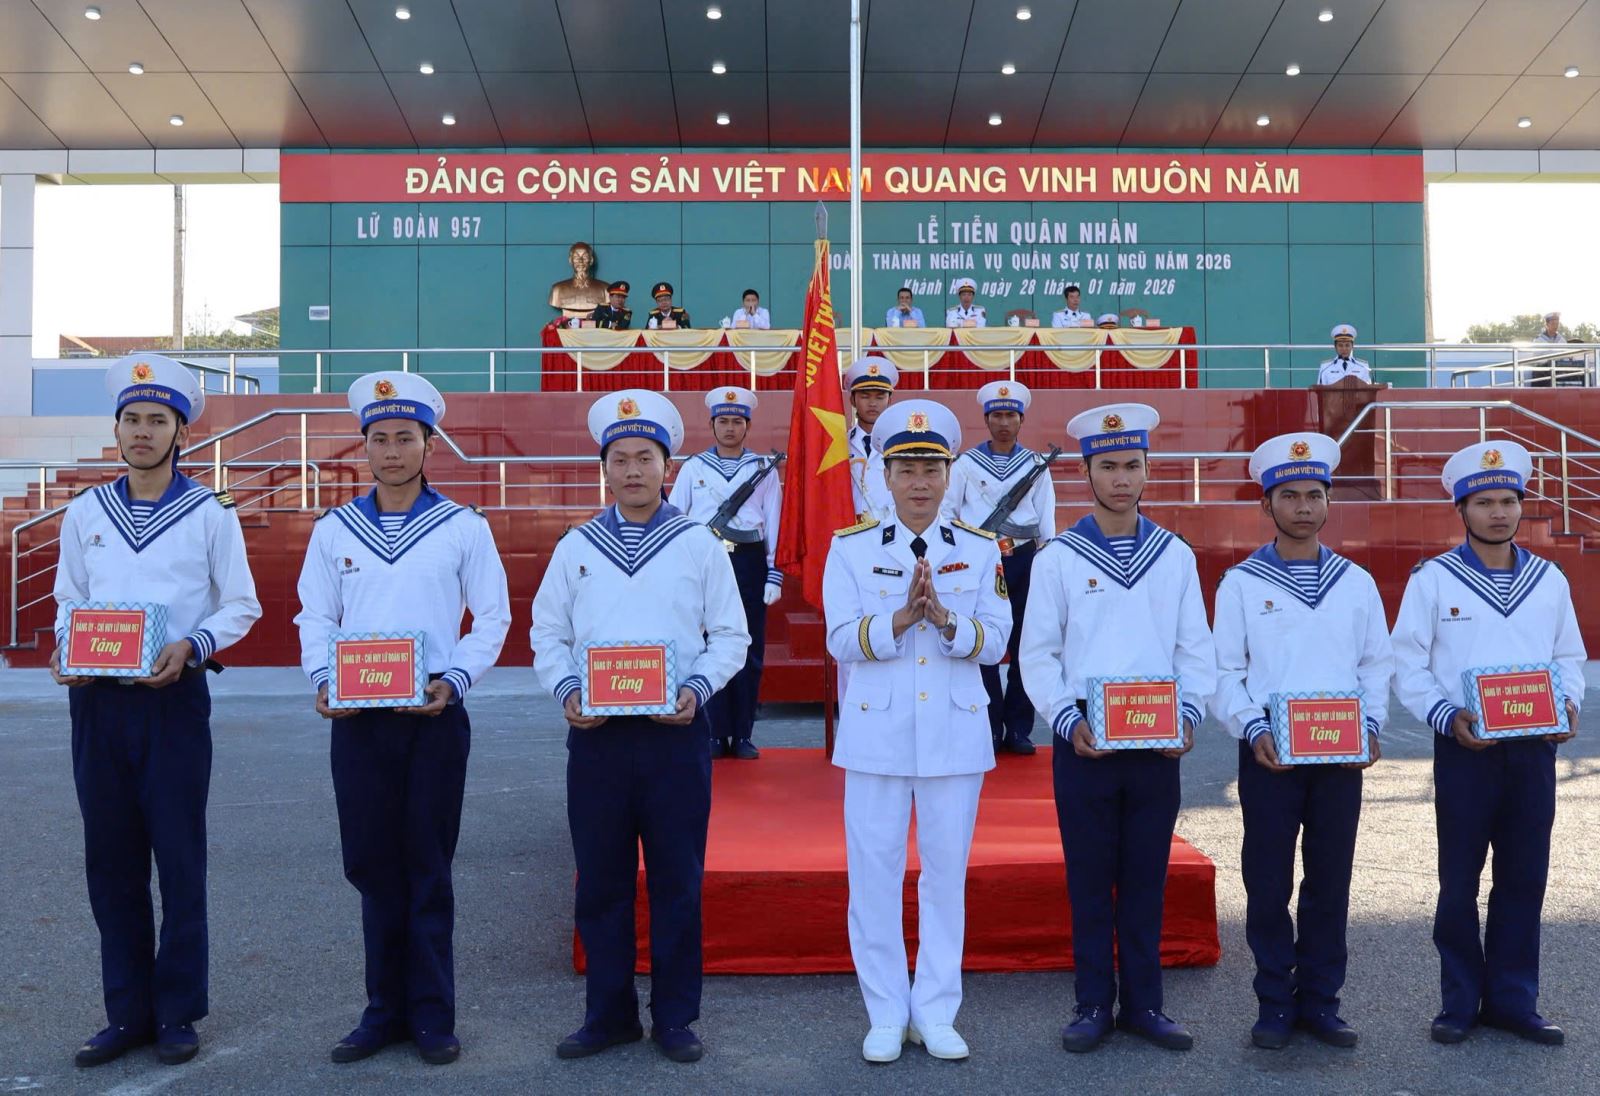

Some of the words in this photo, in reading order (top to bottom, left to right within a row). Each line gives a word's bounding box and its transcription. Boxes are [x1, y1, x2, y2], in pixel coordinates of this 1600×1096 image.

[406, 157, 504, 194] ĐẢNG
[517, 160, 617, 199] CỘNG
[630, 156, 699, 194] SẢN
[712, 160, 785, 199] VIỆT
[798, 167, 872, 193] NAM
[885, 165, 1007, 195] QUANG
[1018, 167, 1097, 193] VINH
[1112, 160, 1211, 194] MUÔN
[1225, 160, 1300, 194] NĂM
[357, 211, 380, 238] LỮ
[393, 212, 439, 238] ĐOÀN
[451, 216, 481, 238] 957
[918, 215, 939, 243] LỄ
[951, 215, 998, 243] TIỄN
[1010, 217, 1067, 245] QUÂN
[1079, 217, 1138, 243] NHÂN
[872, 250, 921, 270] THÀNH
[930, 250, 975, 270] NGHĨA
[984, 253, 1002, 272] VỤ
[1011, 250, 1051, 271] QUÂN
[1060, 252, 1080, 272] SỰ
[1086, 253, 1109, 272] TẠI
[1118, 250, 1147, 270] NGŨ
[1155, 250, 1188, 270] NĂM
[1196, 254, 1231, 270] 2026
[981, 278, 1012, 297] ngày
[1019, 279, 1036, 295] 28
[1088, 279, 1103, 295] 01
[1109, 278, 1136, 295] năm
[1143, 279, 1176, 295] 2026
[140, 388, 155, 398] VIỆT
[386, 403, 400, 414] VIỆT
[401, 404, 416, 414] NAM
[628, 422, 642, 432] VIỆT
[1116, 436, 1129, 446] VIỆT
[1300, 465, 1314, 475] VIỆT
[1493, 474, 1507, 485] VIỆT
[90, 637, 122, 656] Tặng
[359, 668, 392, 688] Tặng
[610, 674, 644, 694] Tặng
[1502, 700, 1534, 718] Tặng
[1126, 710, 1156, 728] Tặng
[1310, 726, 1340, 744] Tặng
